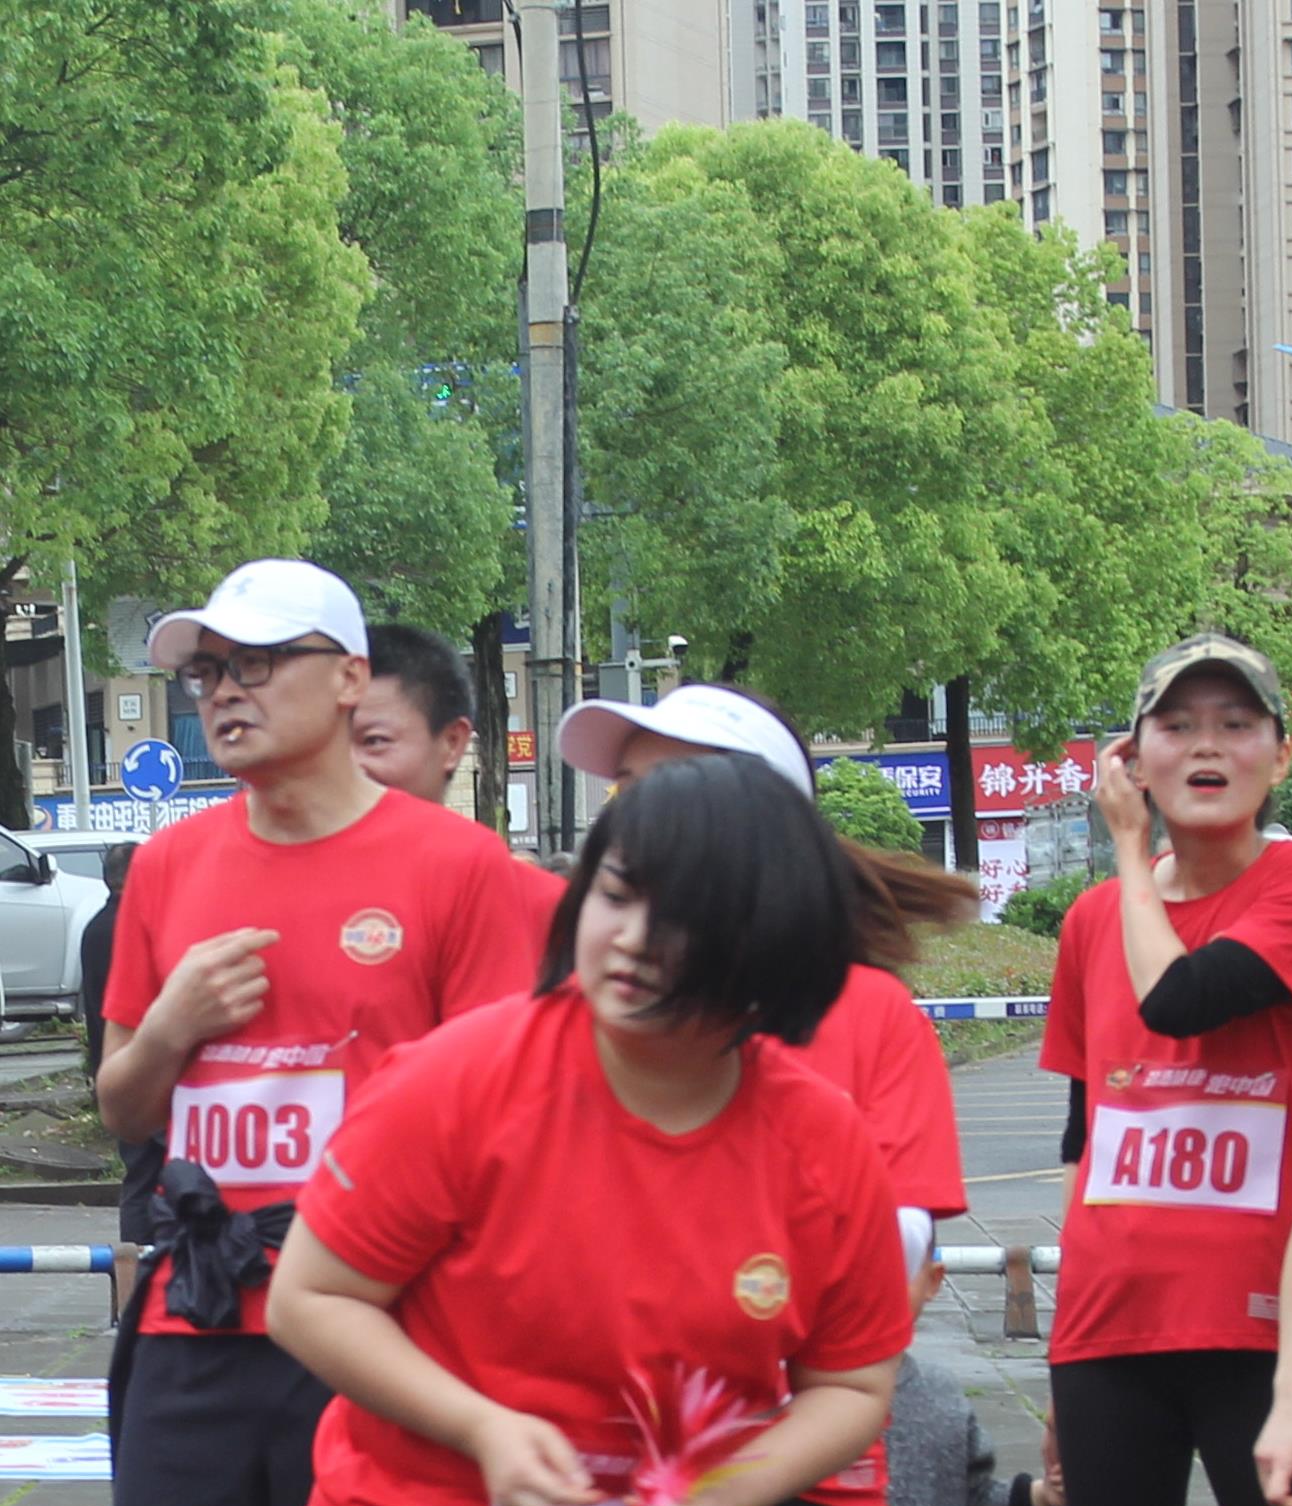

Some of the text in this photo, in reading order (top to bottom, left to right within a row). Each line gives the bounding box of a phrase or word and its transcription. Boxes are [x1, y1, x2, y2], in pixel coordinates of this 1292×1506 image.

[978, 757, 1097, 798] 锦开香
[185, 1103, 311, 1169] A003
[1112, 1126, 1249, 1193] A180
